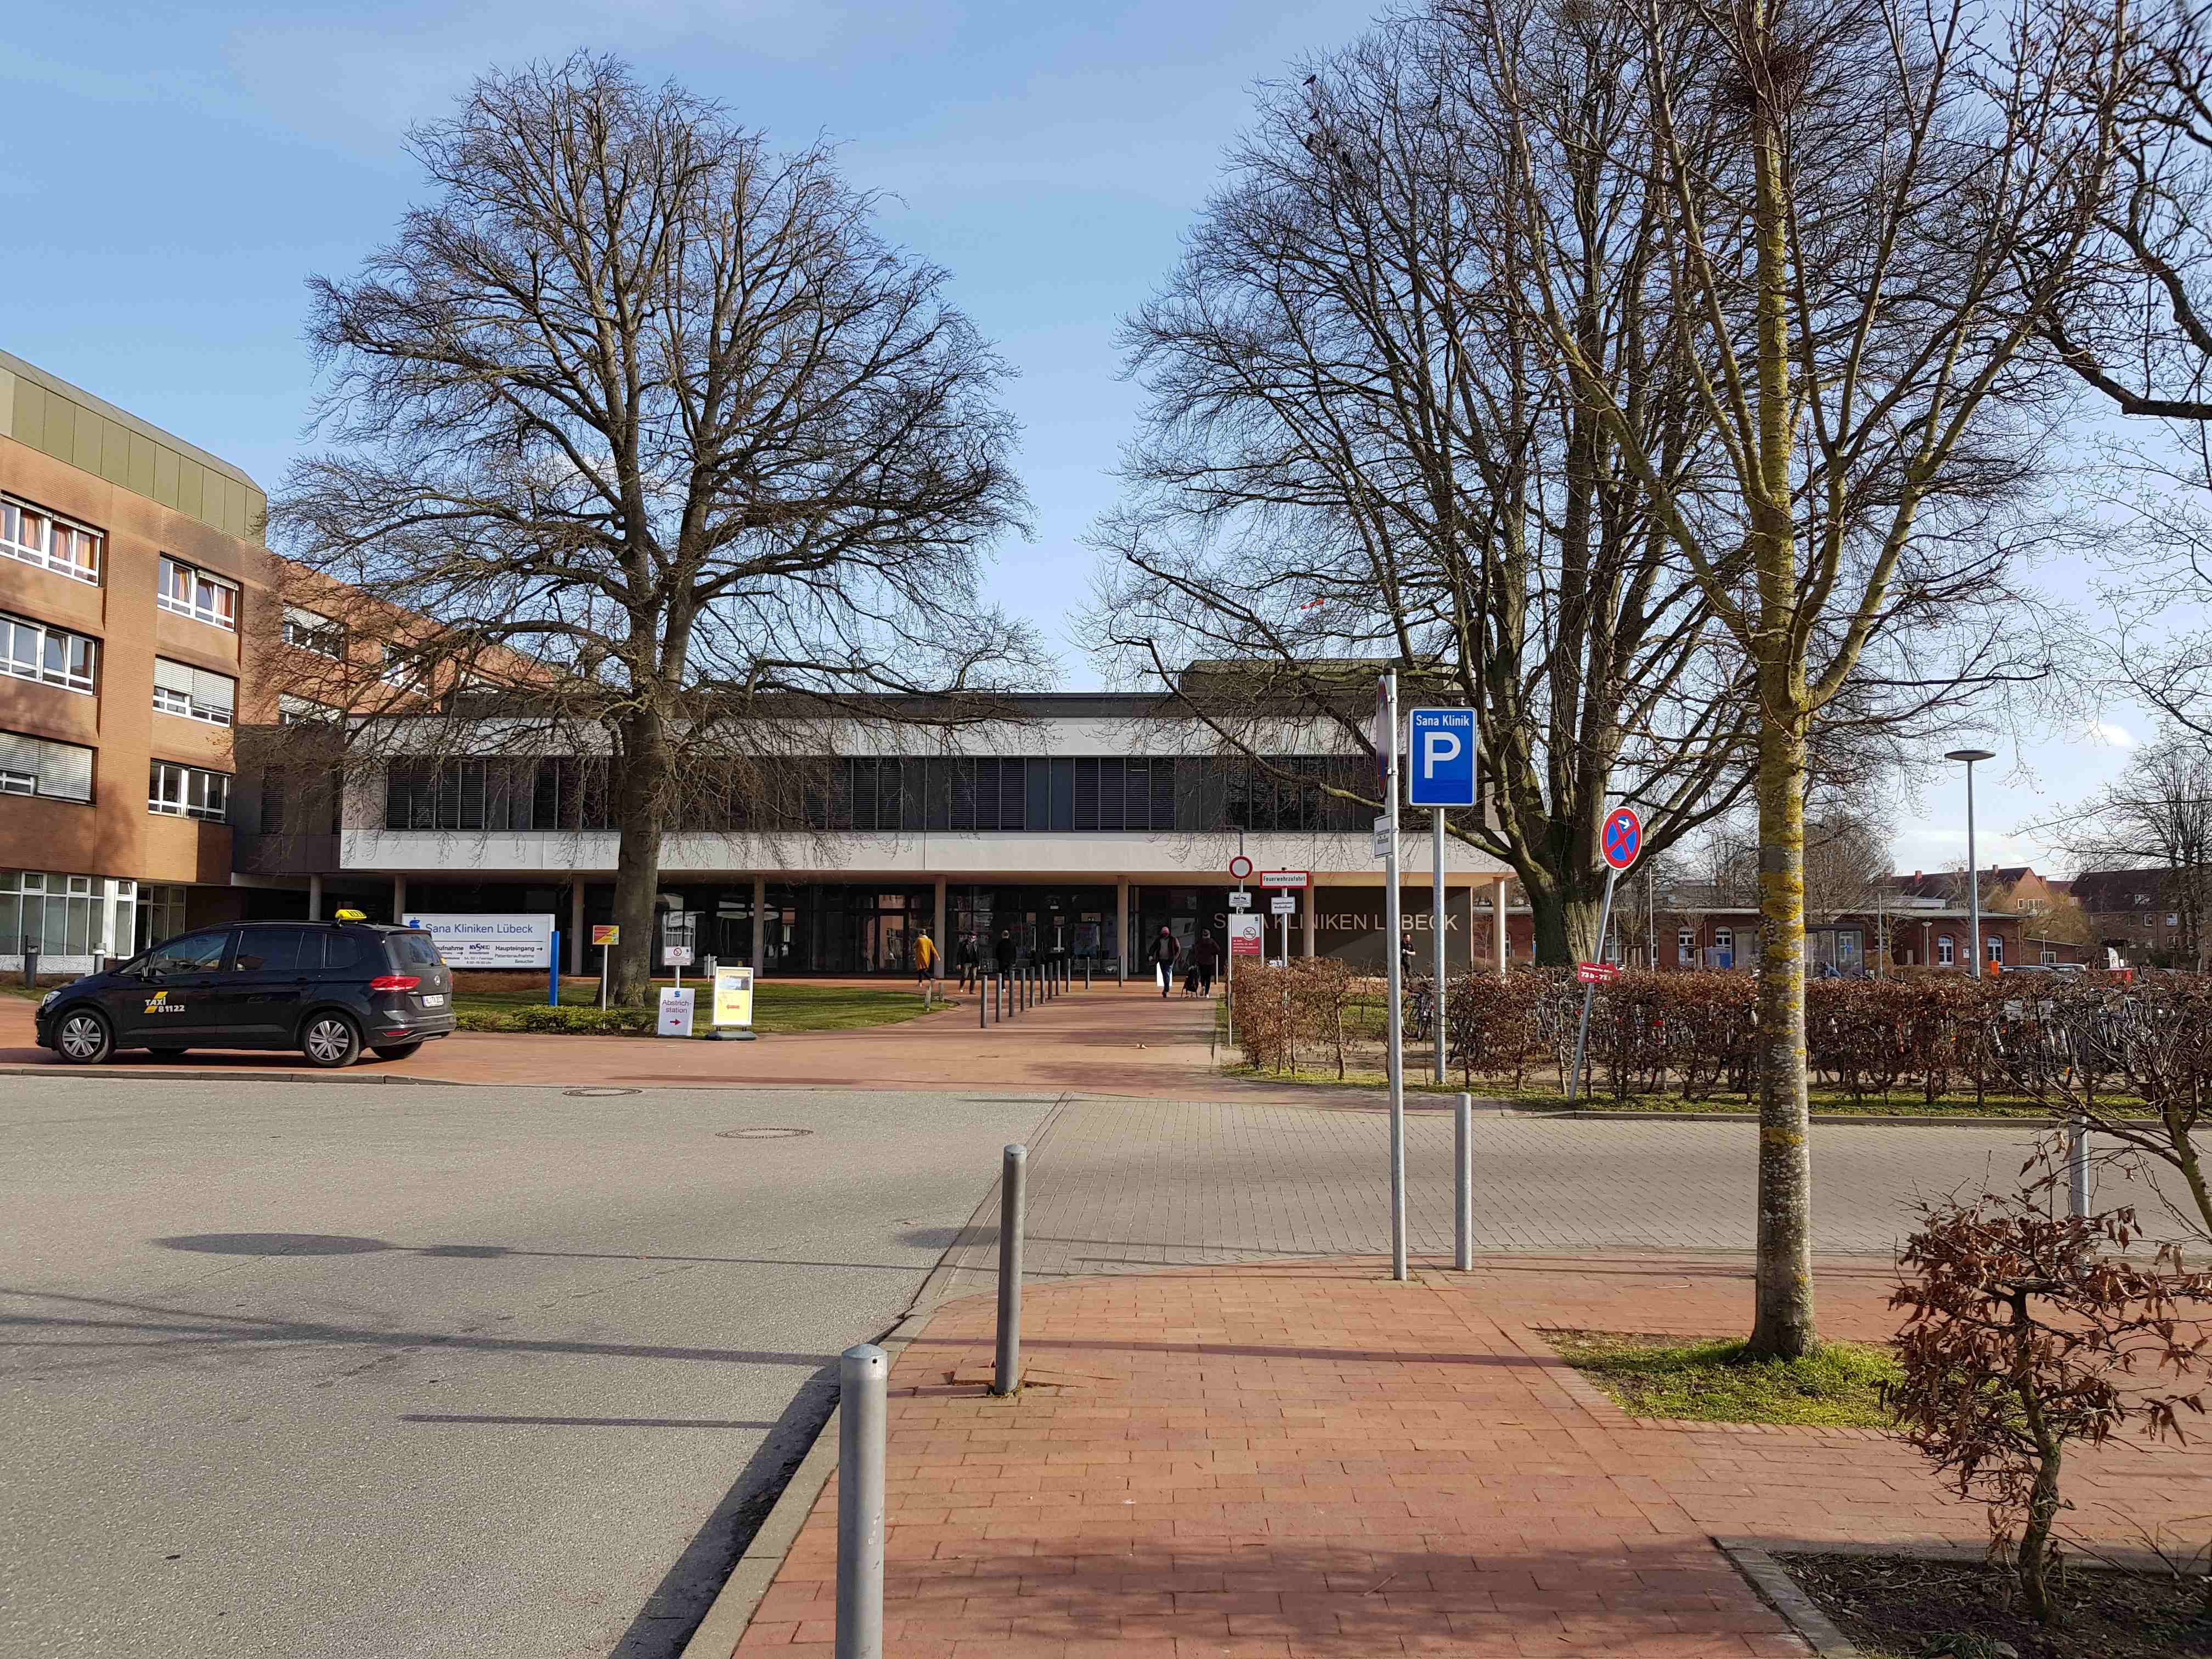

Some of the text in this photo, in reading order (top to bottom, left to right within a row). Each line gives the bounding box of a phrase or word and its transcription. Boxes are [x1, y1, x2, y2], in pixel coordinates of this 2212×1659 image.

[1416, 715, 1470, 726] Sana Klinik
[1424, 731, 1461, 778] P
[426, 923, 533, 933] Sana Kliniken Lübeck
[1274, 914, 1367, 930] KLIIKEN
[1374, 914, 1458, 930] LBEK
